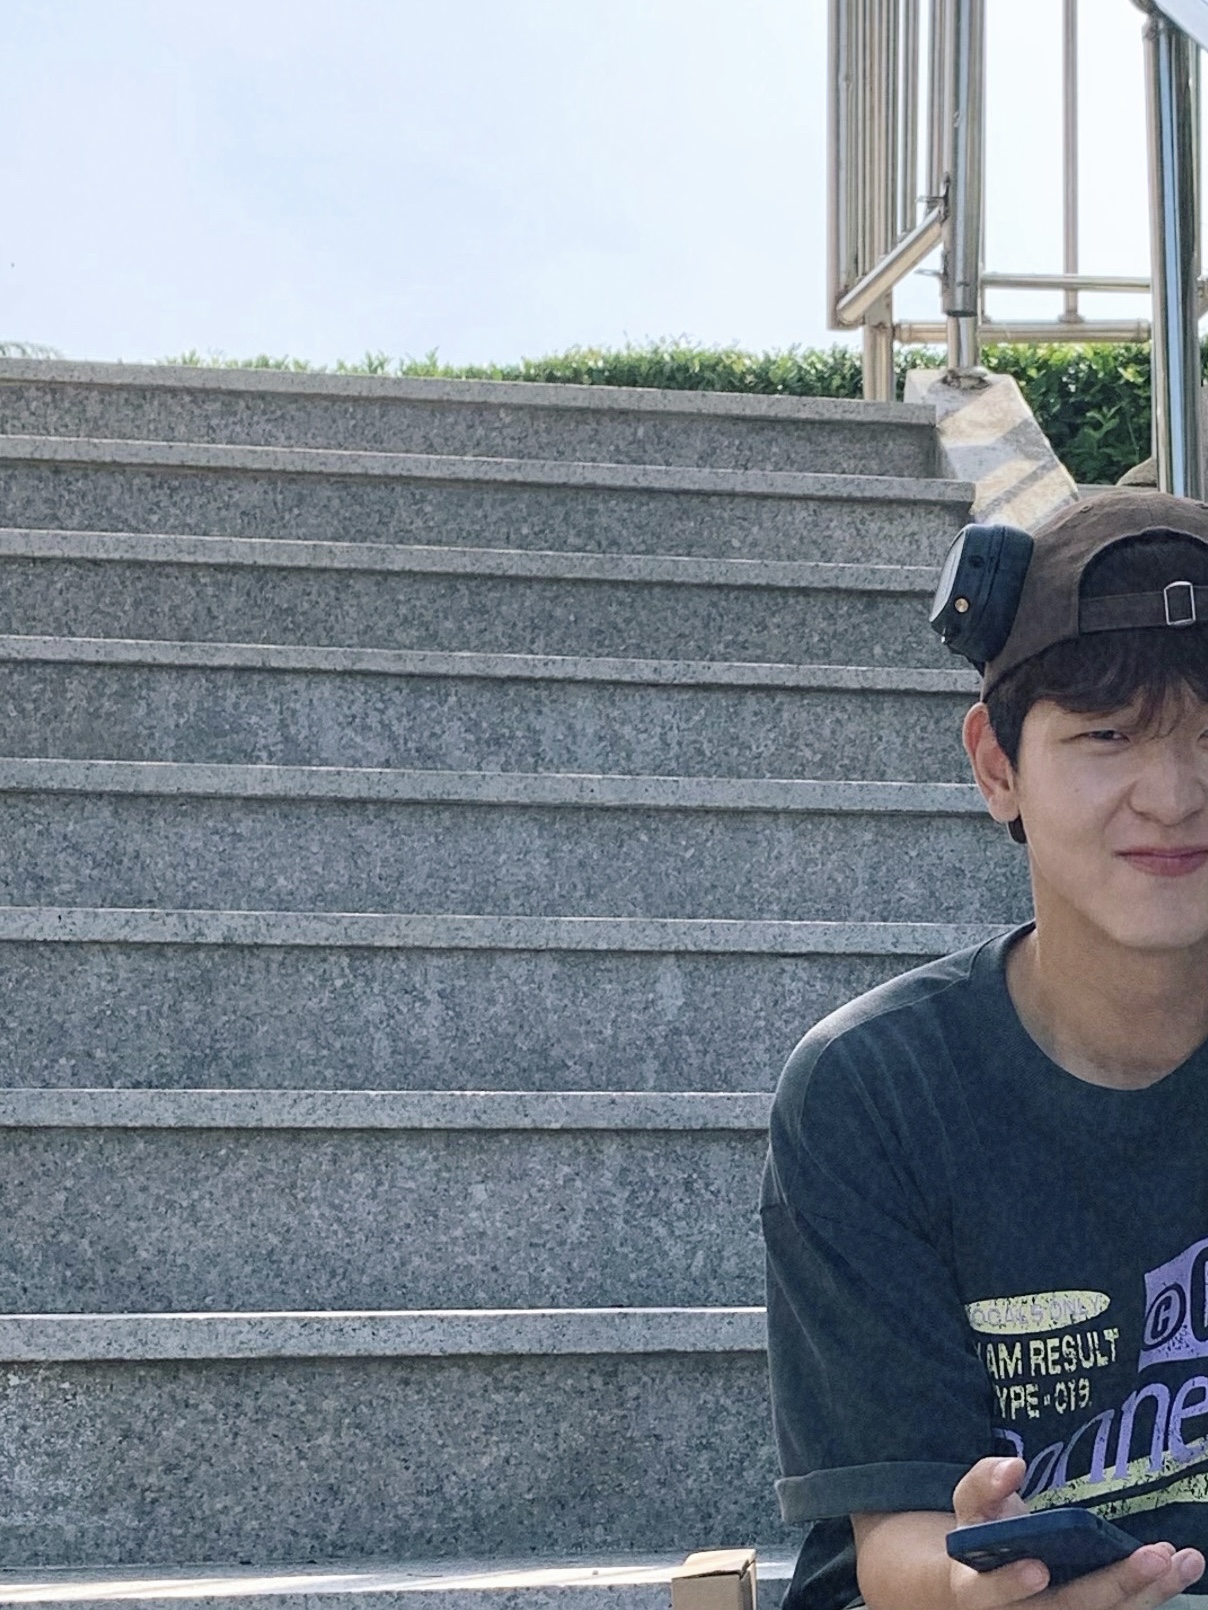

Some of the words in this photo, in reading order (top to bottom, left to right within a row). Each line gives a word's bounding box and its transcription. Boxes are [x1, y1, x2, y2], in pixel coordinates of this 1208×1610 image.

[968, 1301, 1044, 1327] OCALS
[1029, 1327, 1120, 1377] RESULT
[993, 1378, 1091, 1420] YPE-019
